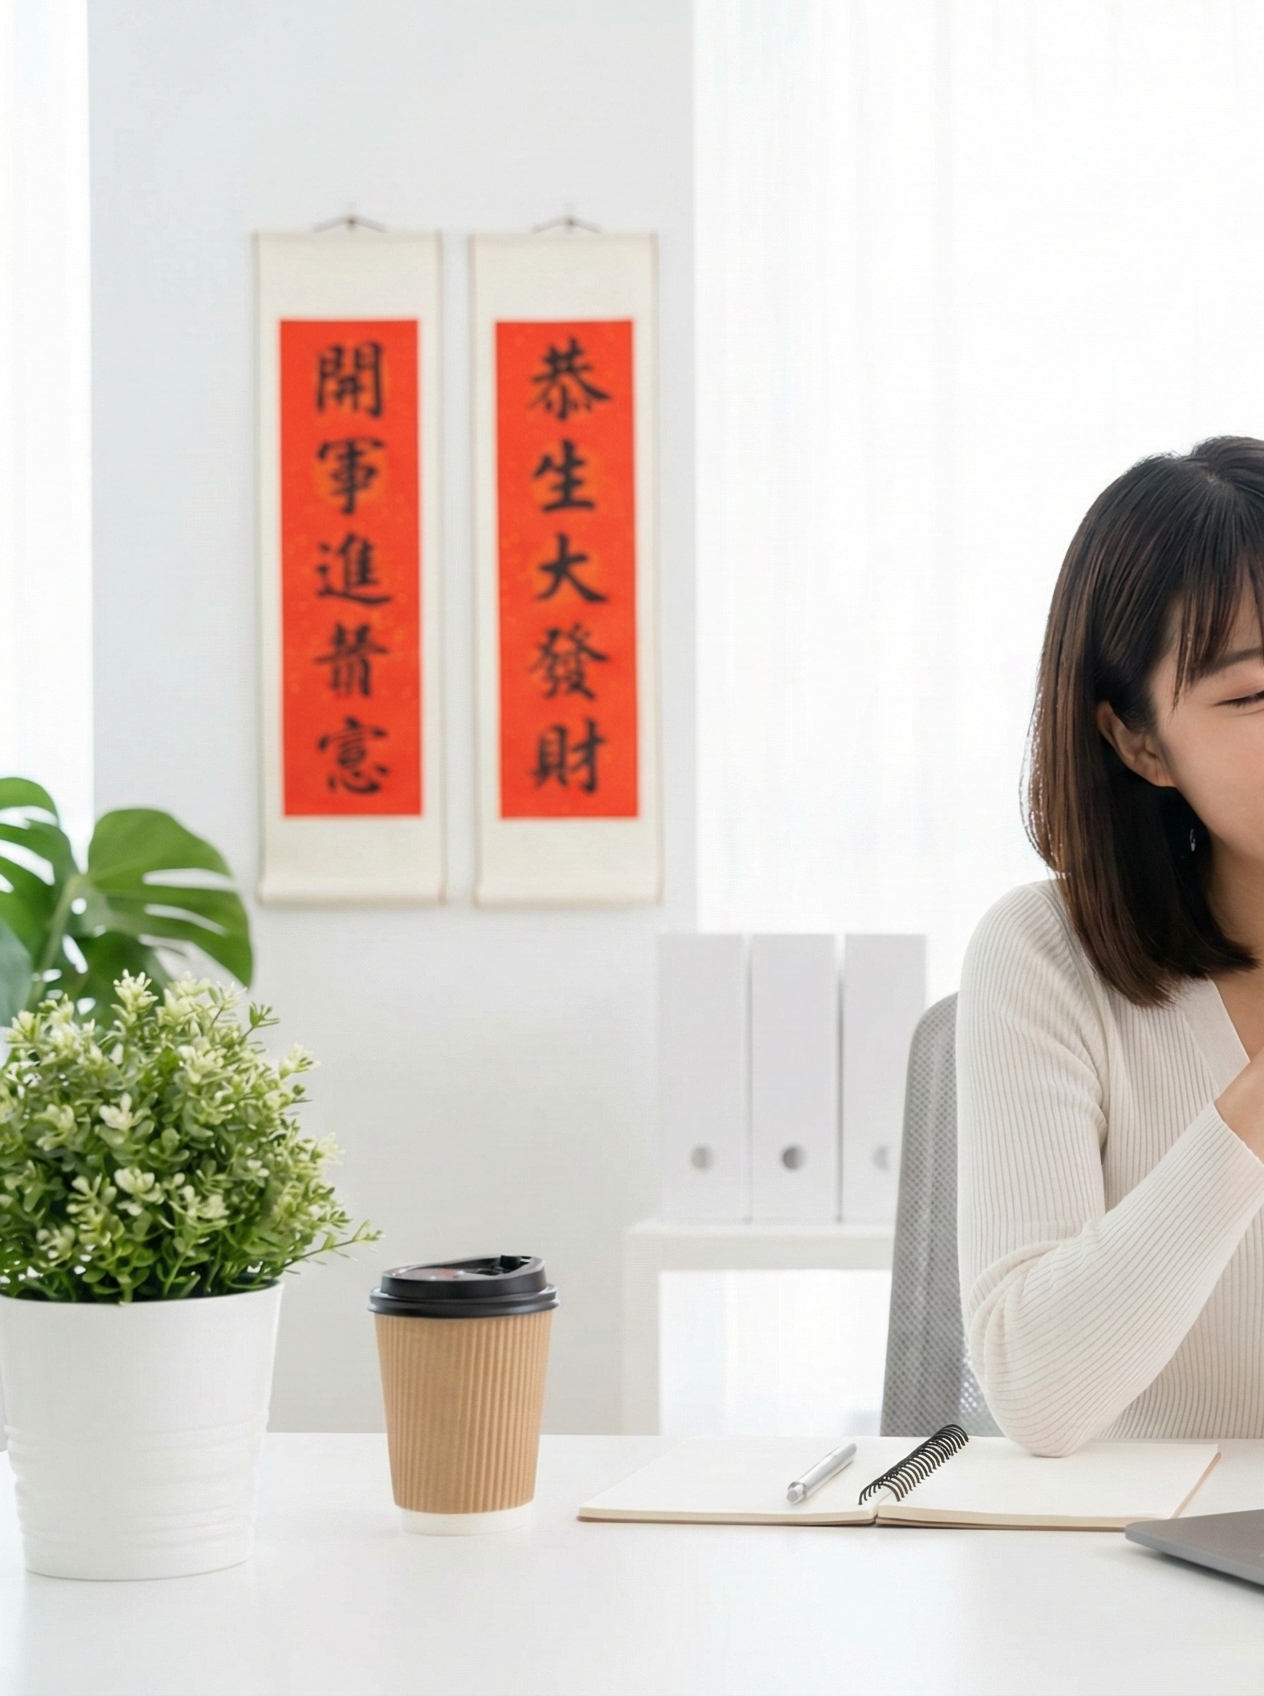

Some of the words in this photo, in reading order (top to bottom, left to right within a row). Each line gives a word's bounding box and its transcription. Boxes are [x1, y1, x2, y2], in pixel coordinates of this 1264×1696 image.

[530, 336, 611, 796] 恭生大發財
